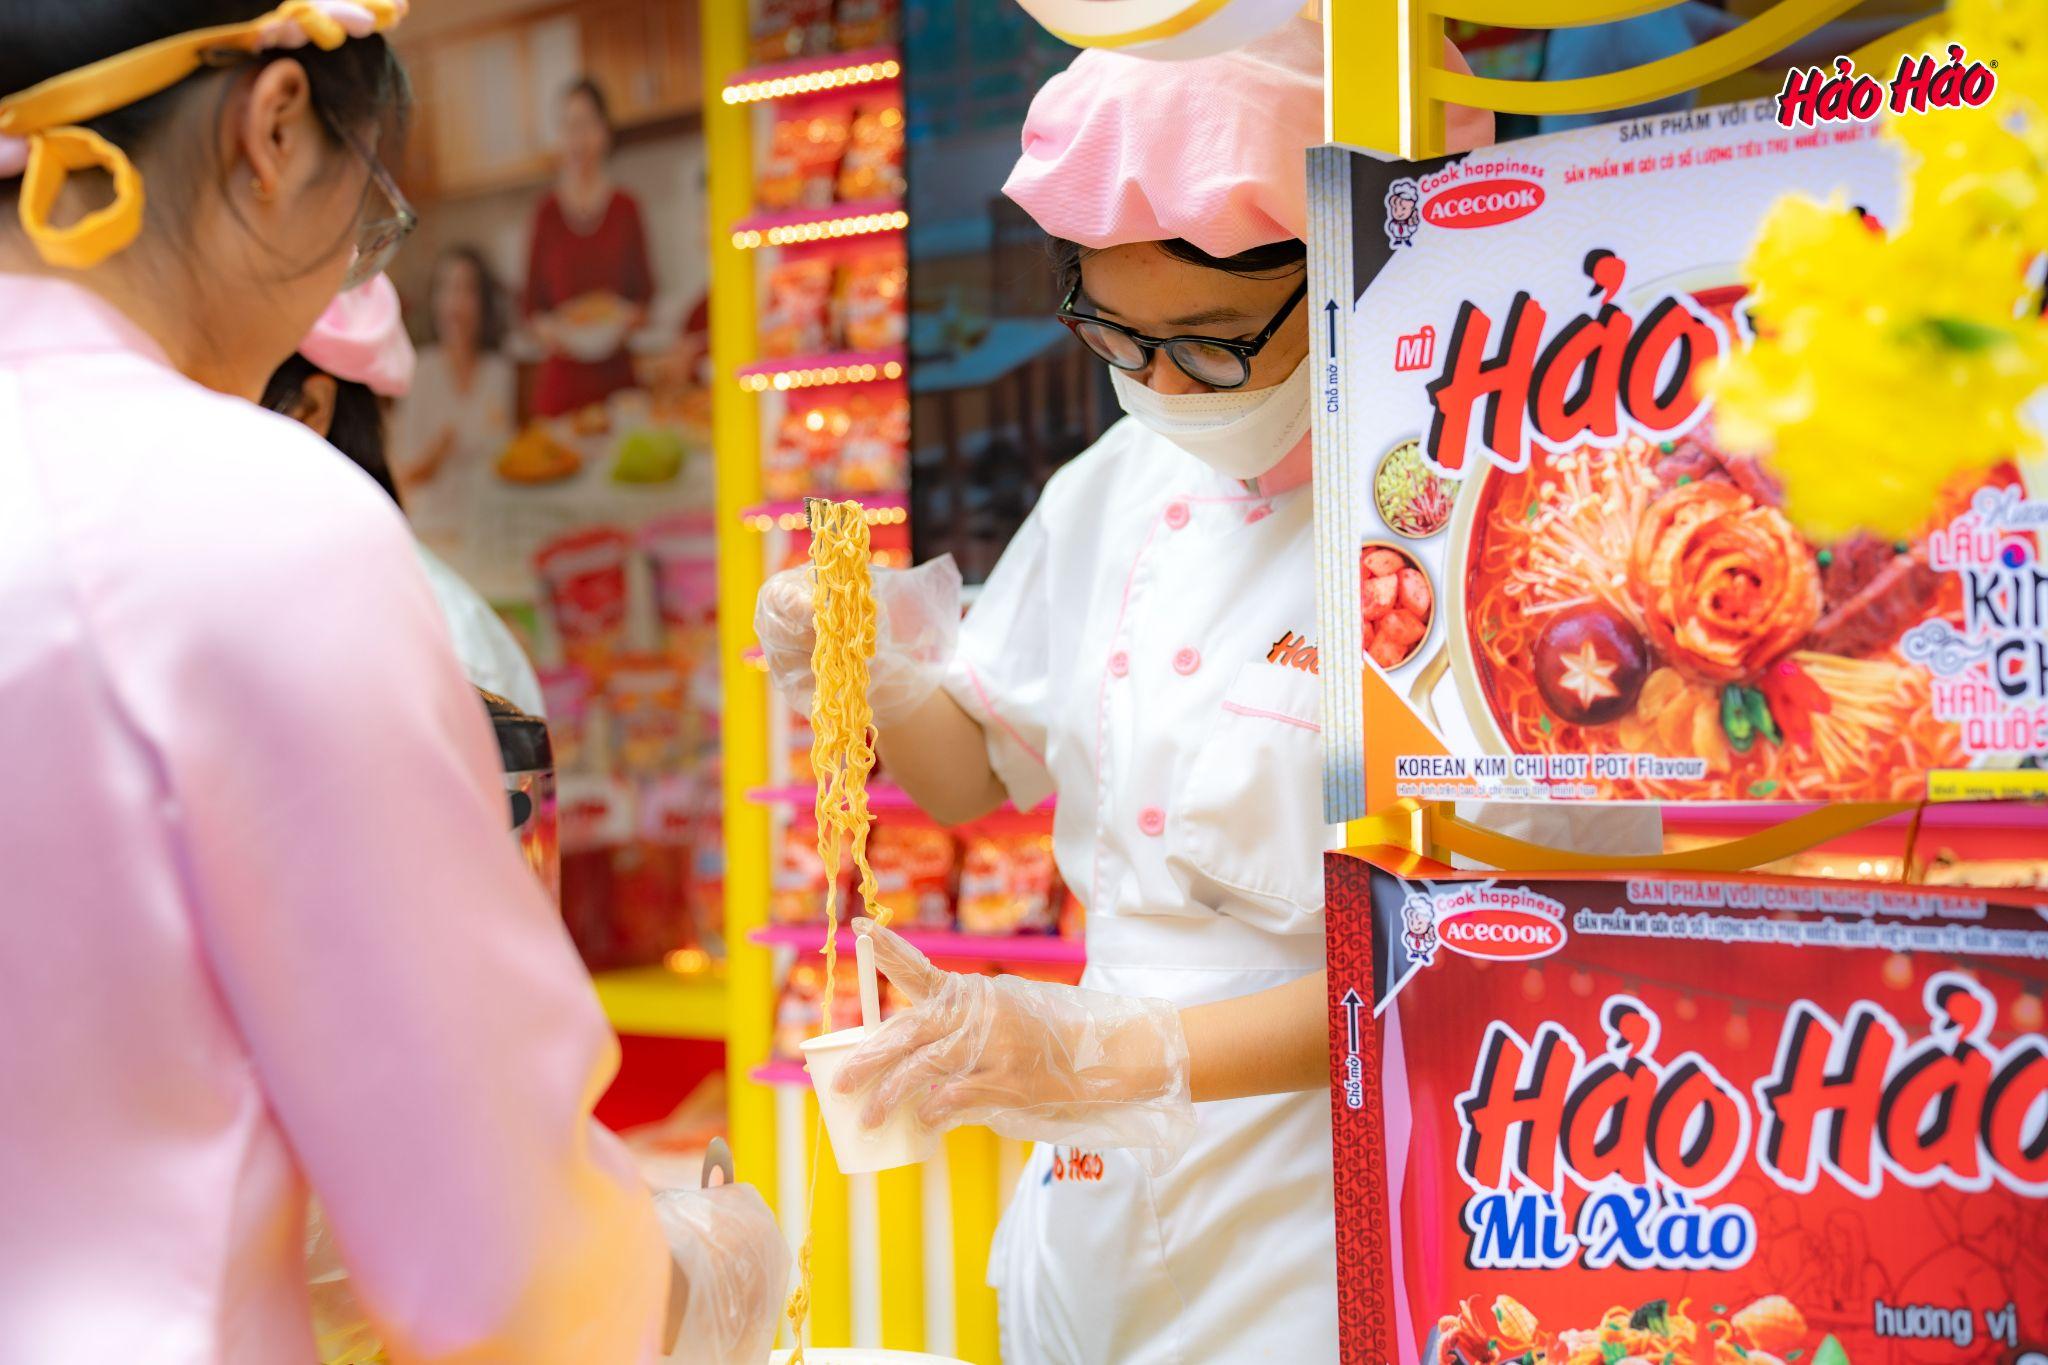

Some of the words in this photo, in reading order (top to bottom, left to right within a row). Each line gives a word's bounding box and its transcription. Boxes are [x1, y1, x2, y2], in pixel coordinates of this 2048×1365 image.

[1421, 166, 1460, 194] Cook
[1465, 158, 1544, 180] happiness
[1424, 248, 1723, 474] Hảo
[1398, 757, 1466, 776] KOREAN
[1475, 757, 1506, 776] KIM
[1514, 757, 1543, 776] CHI
[1552, 758, 1588, 776] HOT
[1595, 758, 1629, 777] POT
[1637, 757, 1703, 777] Flavour
[1437, 889, 1476, 912] Cook
[1480, 888, 1561, 918] happiness
[1458, 998, 1745, 1196] Hảo
[1470, 1193, 1573, 1260] Mì
[1586, 1187, 1748, 1260] Xào
[1875, 1299, 1973, 1347] hương
[1985, 1302, 2018, 1348] vị
